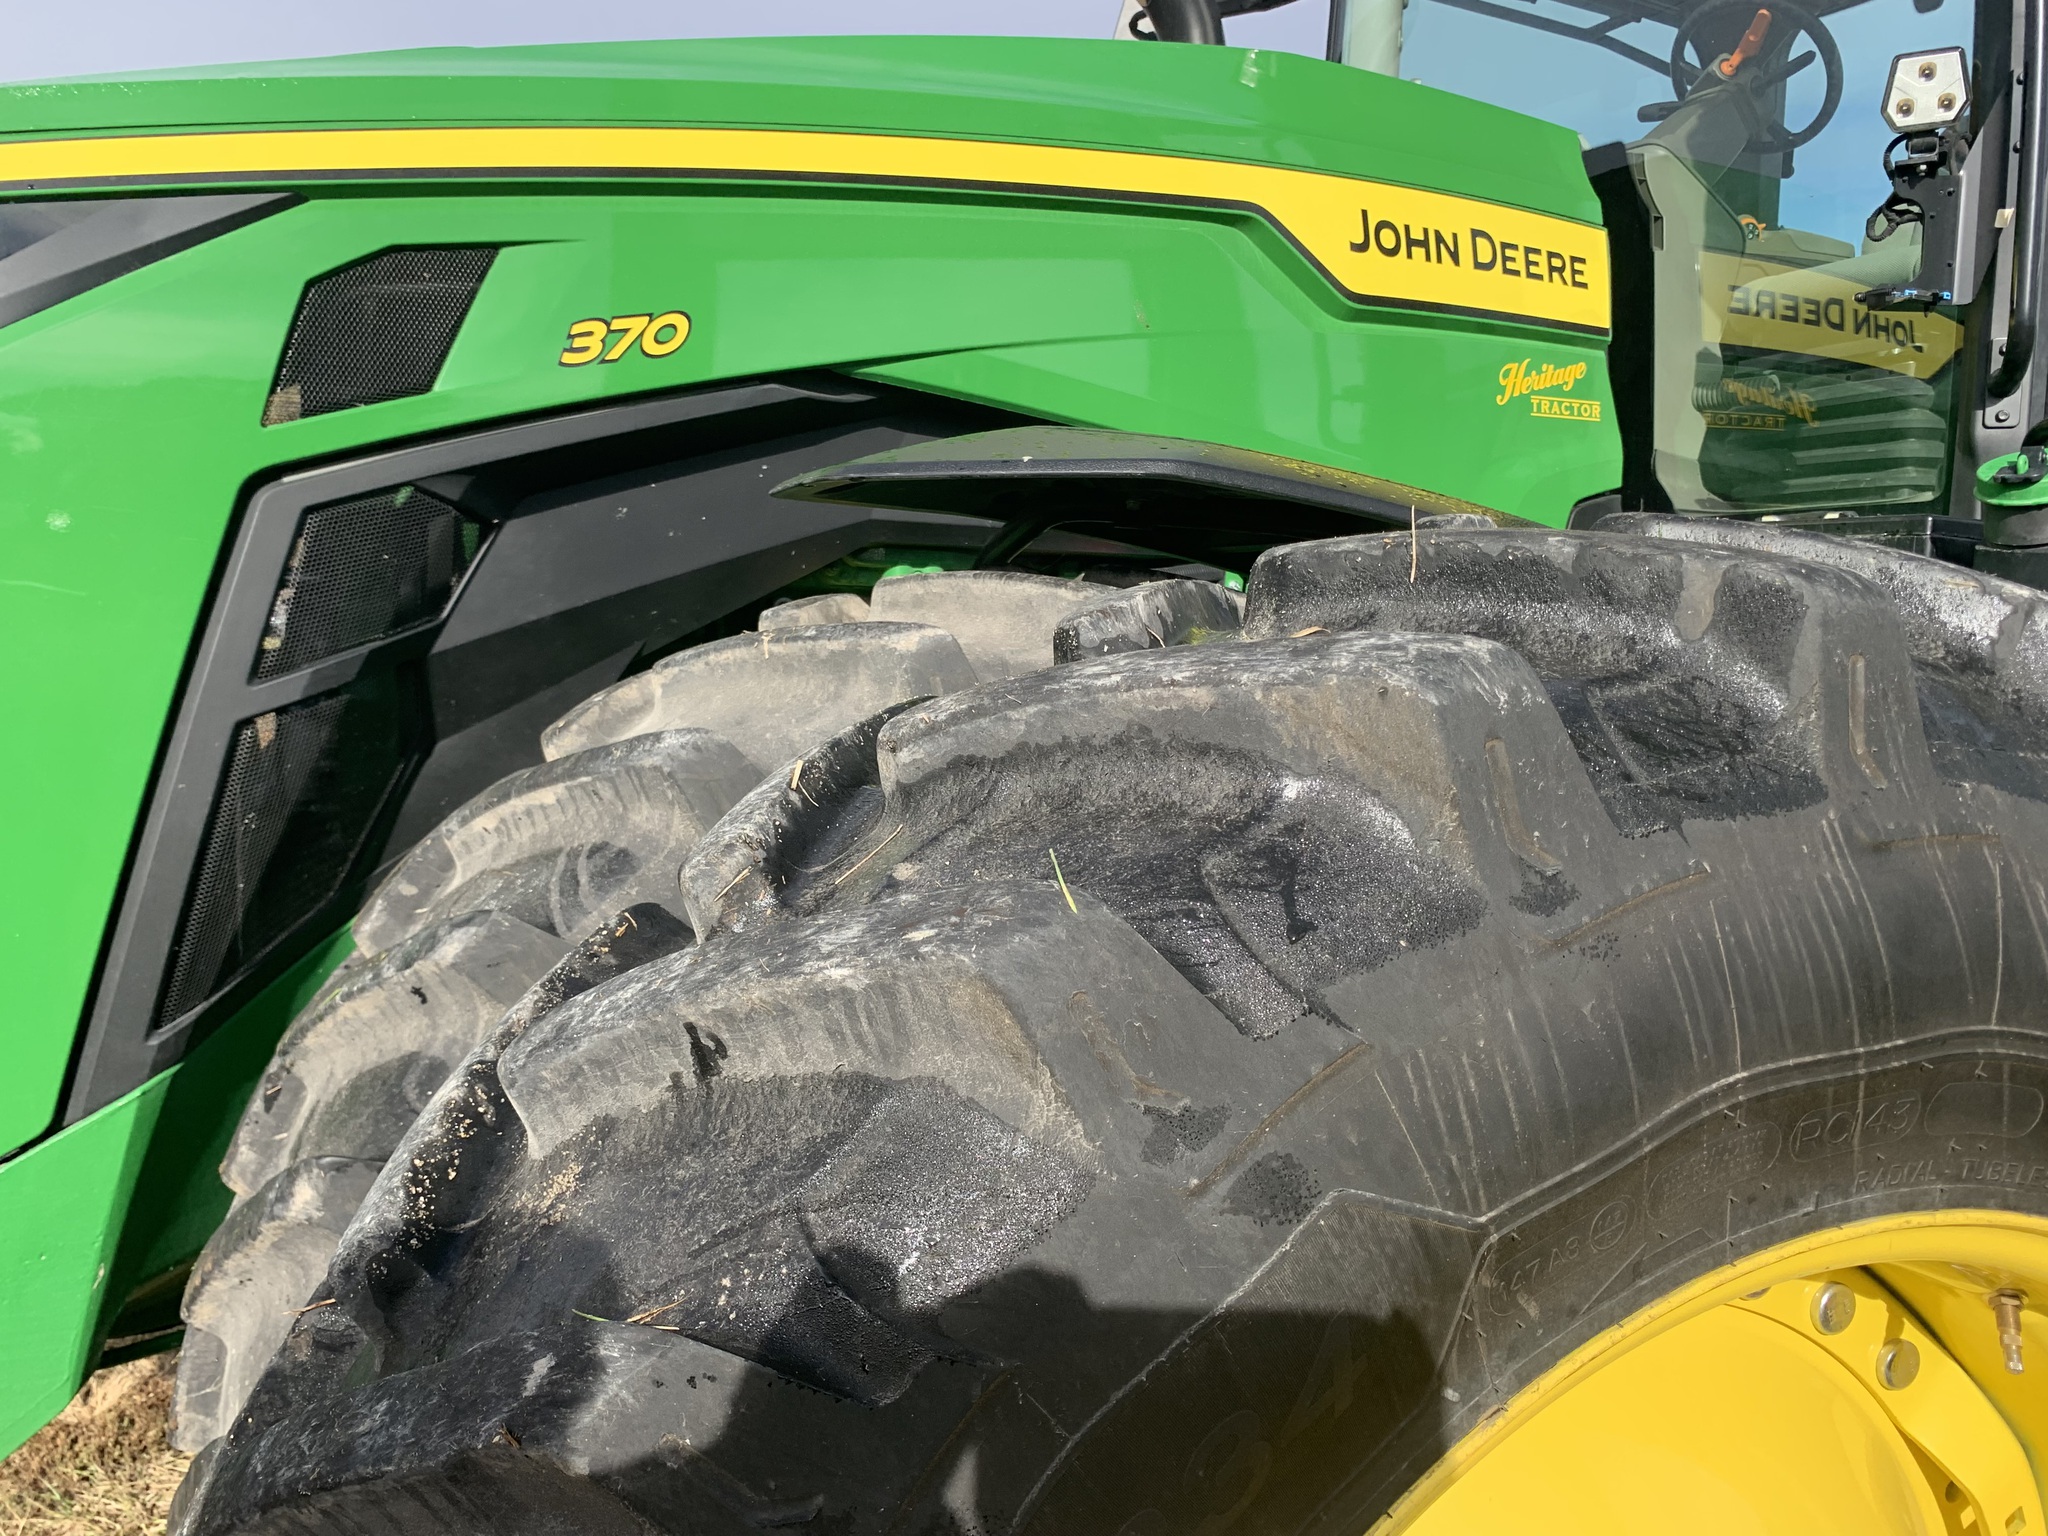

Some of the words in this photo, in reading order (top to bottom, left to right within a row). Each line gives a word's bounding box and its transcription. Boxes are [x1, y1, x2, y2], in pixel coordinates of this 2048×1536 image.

[1350, 208, 1460, 267] JOHN
[1470, 227, 1589, 290] DEERE
[558, 310, 692, 367] 370
[1496, 358, 1587, 405] Heritage
[1531, 398, 1601, 419] TRACTOR
[1852, 1159, 1938, 1194] RADIAL
[1961, 1157, 2048, 1189] TUBELE
